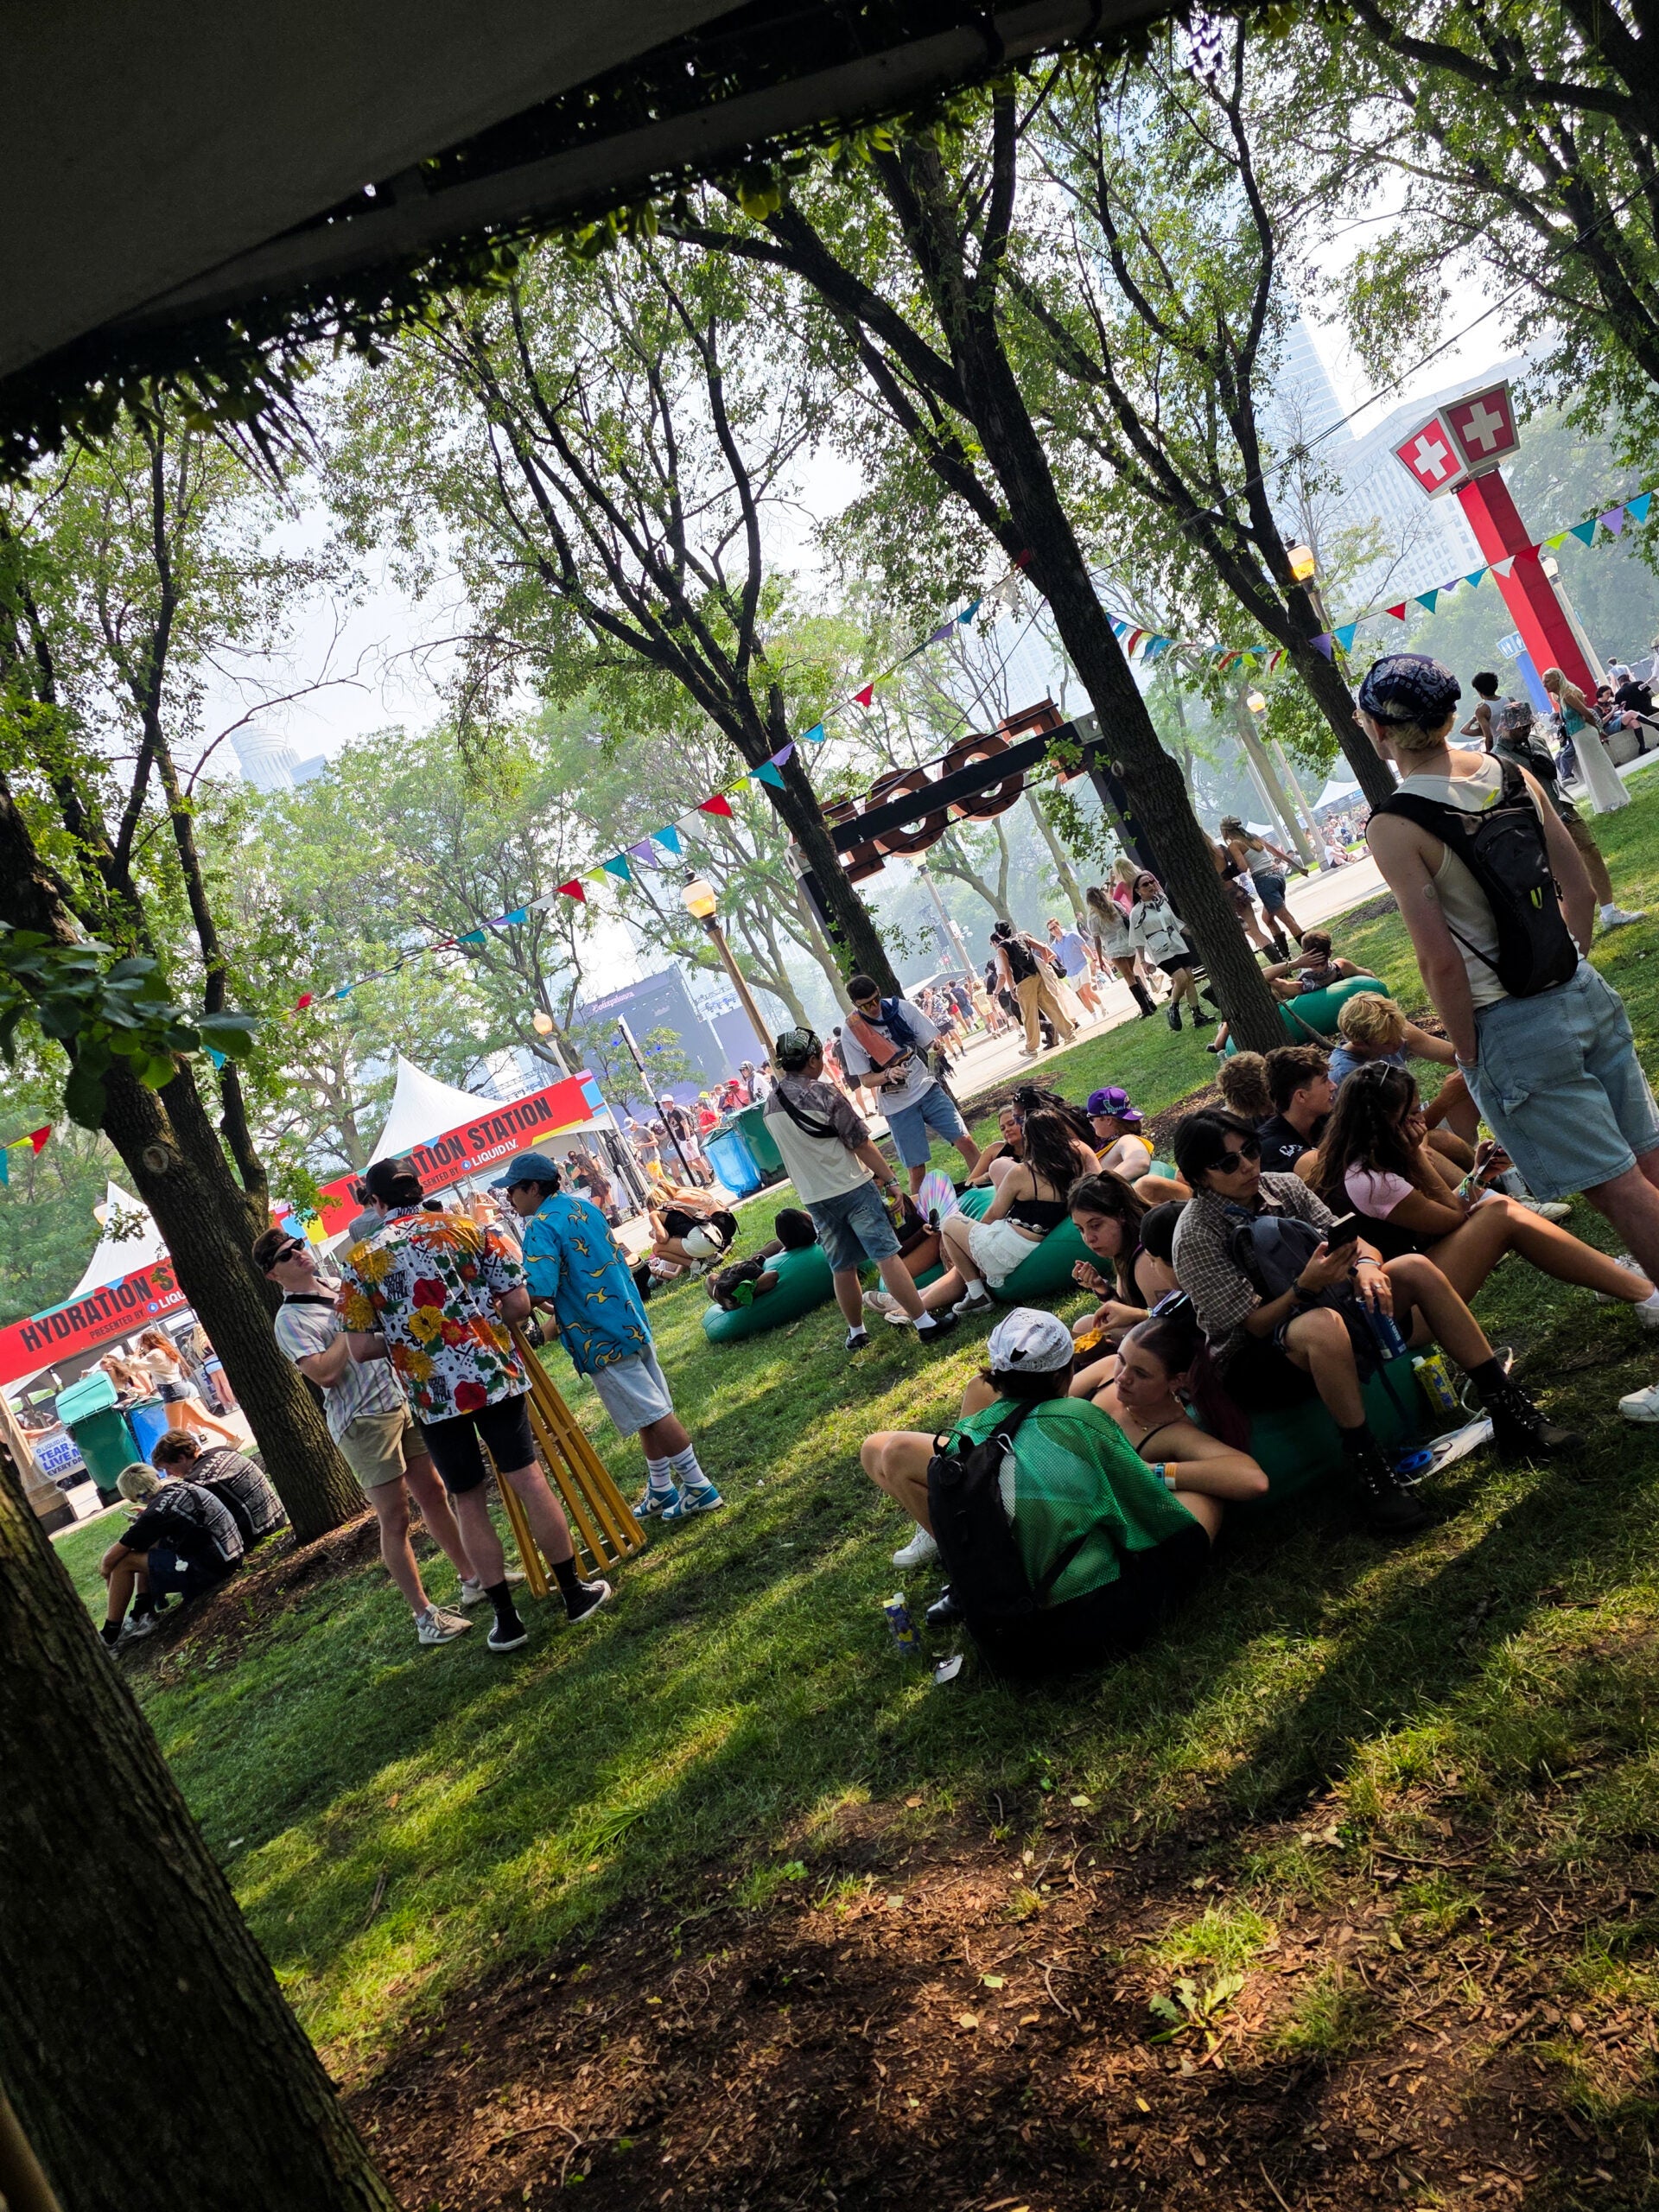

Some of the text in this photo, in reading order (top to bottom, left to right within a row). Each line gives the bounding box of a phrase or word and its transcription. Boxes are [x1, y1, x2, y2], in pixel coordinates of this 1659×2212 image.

[467, 1096, 553, 1150] STATION
[422, 1172, 449, 1188] SENTED
[450, 1166, 460, 1176] BY
[472, 1144, 508, 1166] LIQUID
[19, 1276, 154, 1352] HYDRATION
[89, 1290, 187, 1339] PRESENTED BY LIQU
[42, 1452, 71, 1471] LIVE
[47, 1456, 82, 1477] EVERY DA
